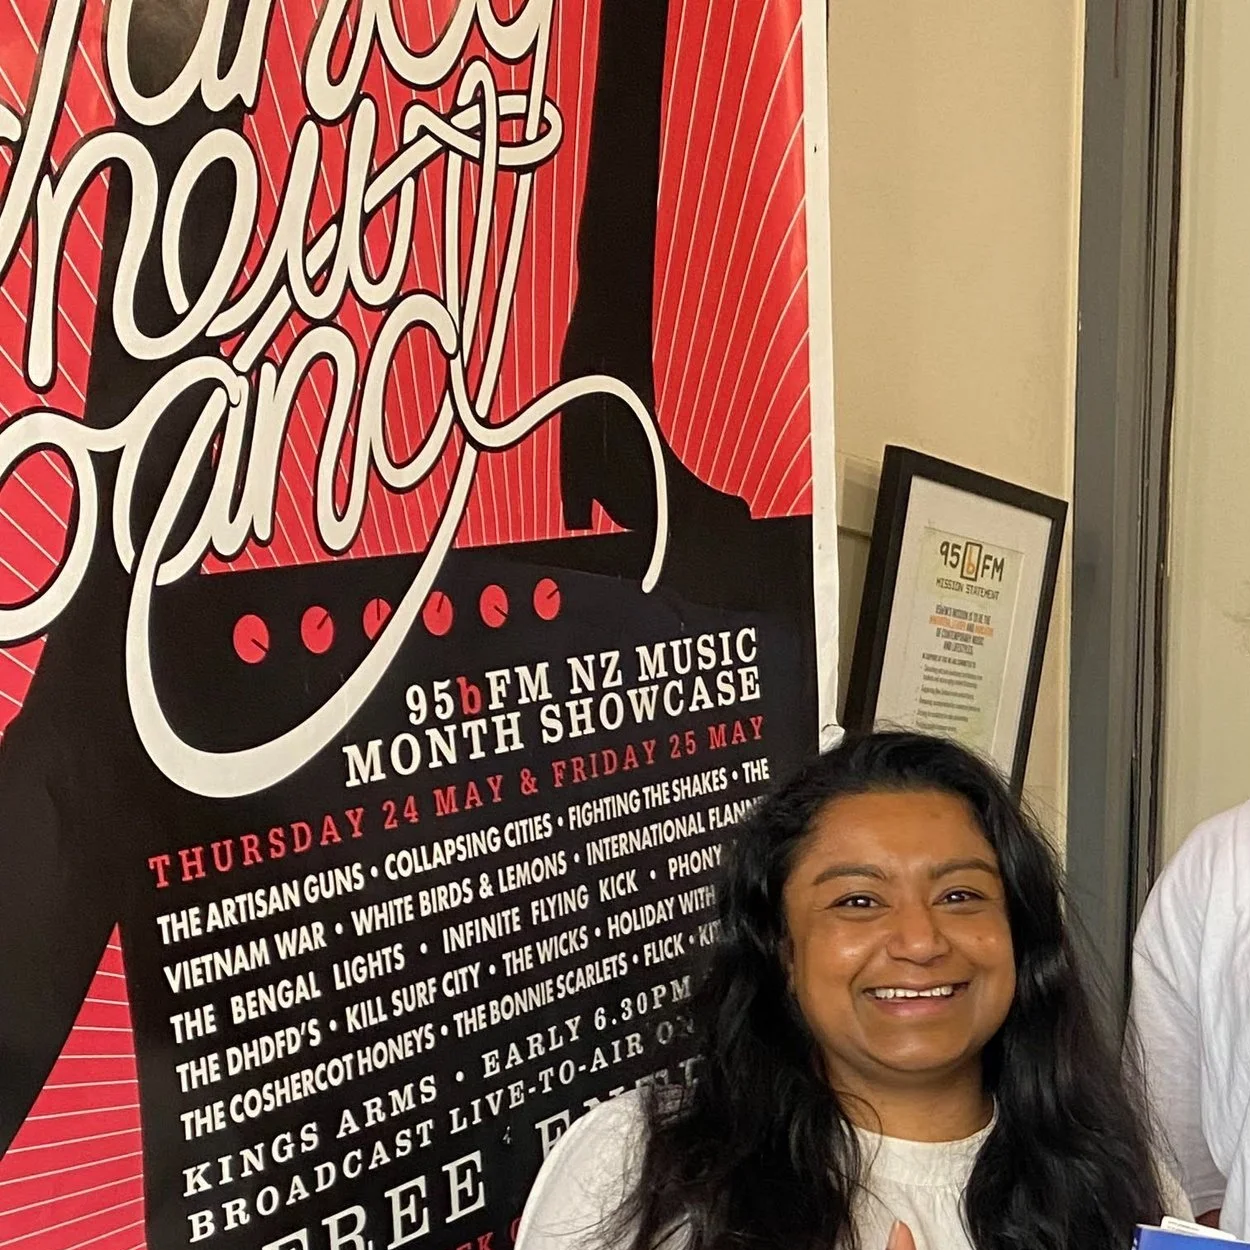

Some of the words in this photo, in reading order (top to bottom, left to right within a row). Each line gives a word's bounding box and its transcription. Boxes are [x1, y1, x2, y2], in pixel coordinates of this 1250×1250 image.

[405, 661, 553, 725] 95bFM
[566, 650, 623, 695] NZ
[635, 627, 758, 682] MUSIC
[935, 577, 963, 597] MISSION
[964, 582, 1000, 601] STATEMENT
[148, 807, 365, 888] THURSDAY
[382, 795, 419, 830] 24
[433, 774, 504, 817] MAY
[519, 767, 539, 796] &
[551, 739, 657, 788] FRIDAY
[669, 730, 697, 759] 25
[707, 715, 766, 750] MAY
[342, 711, 525, 788] MONTH
[541, 665, 761, 744] SHOWCASE
[157, 905, 203, 945] THE
[206, 879, 301, 934] ARTISAN
[303, 862, 365, 904] GUNS
[384, 826, 501, 880] COLLAPSING
[504, 812, 553, 848] CITIES
[568, 789, 641, 831] FIGHTING
[642, 781, 671, 810] THE
[671, 767, 728, 802] SHAKES
[742, 757, 770, 785] THE
[163, 937, 271, 994] VIETNAM
[273, 921, 328, 962] WAR
[350, 894, 415, 938] WHITE
[419, 877, 474, 918] BIRDS
[478, 872, 495, 900] &
[498, 850, 568, 894] LEMONS
[585, 811, 706, 866] INTERNATIONAL
[170, 1003, 217, 1044] THE
[230, 971, 321, 1025] BENGAL
[332, 943, 406, 990] LIGHTS
[443, 906, 521, 954] INFINITE
[530, 884, 589, 925] FLYING
[598, 868, 638, 902] KICK
[667, 843, 722, 881] PHONY
[176, 1053, 221, 1093] THE
[227, 1017, 321, 1076] DHDFD'S
[345, 996, 388, 1033] KILL
[391, 976, 437, 1017] SURF
[441, 961, 482, 998] CITY
[502, 948, 534, 977] THE
[535, 925, 588, 964] WICKS
[606, 896, 675, 939] HOLIDAY
[679, 883, 717, 916] WITH
[180, 1101, 226, 1141] THE
[229, 1053, 355, 1124] COSHERCOT
[357, 1022, 435, 1076] HONEYS
[453, 1006, 487, 1038] THE
[489, 980, 555, 1025] BONNIE
[556, 951, 629, 1000] SCARLETS
[642, 932, 685, 967] FLICK
[181, 1122, 320, 1198] KINGS
[336, 1074, 438, 1139] ARMS
[481, 1015, 582, 1079] EARLY
[594, 975, 692, 1031] 6.30PM
[187, 1118, 435, 1243] BROADCAST
[449, 1032, 645, 1135] LIVE-TO-AIR
